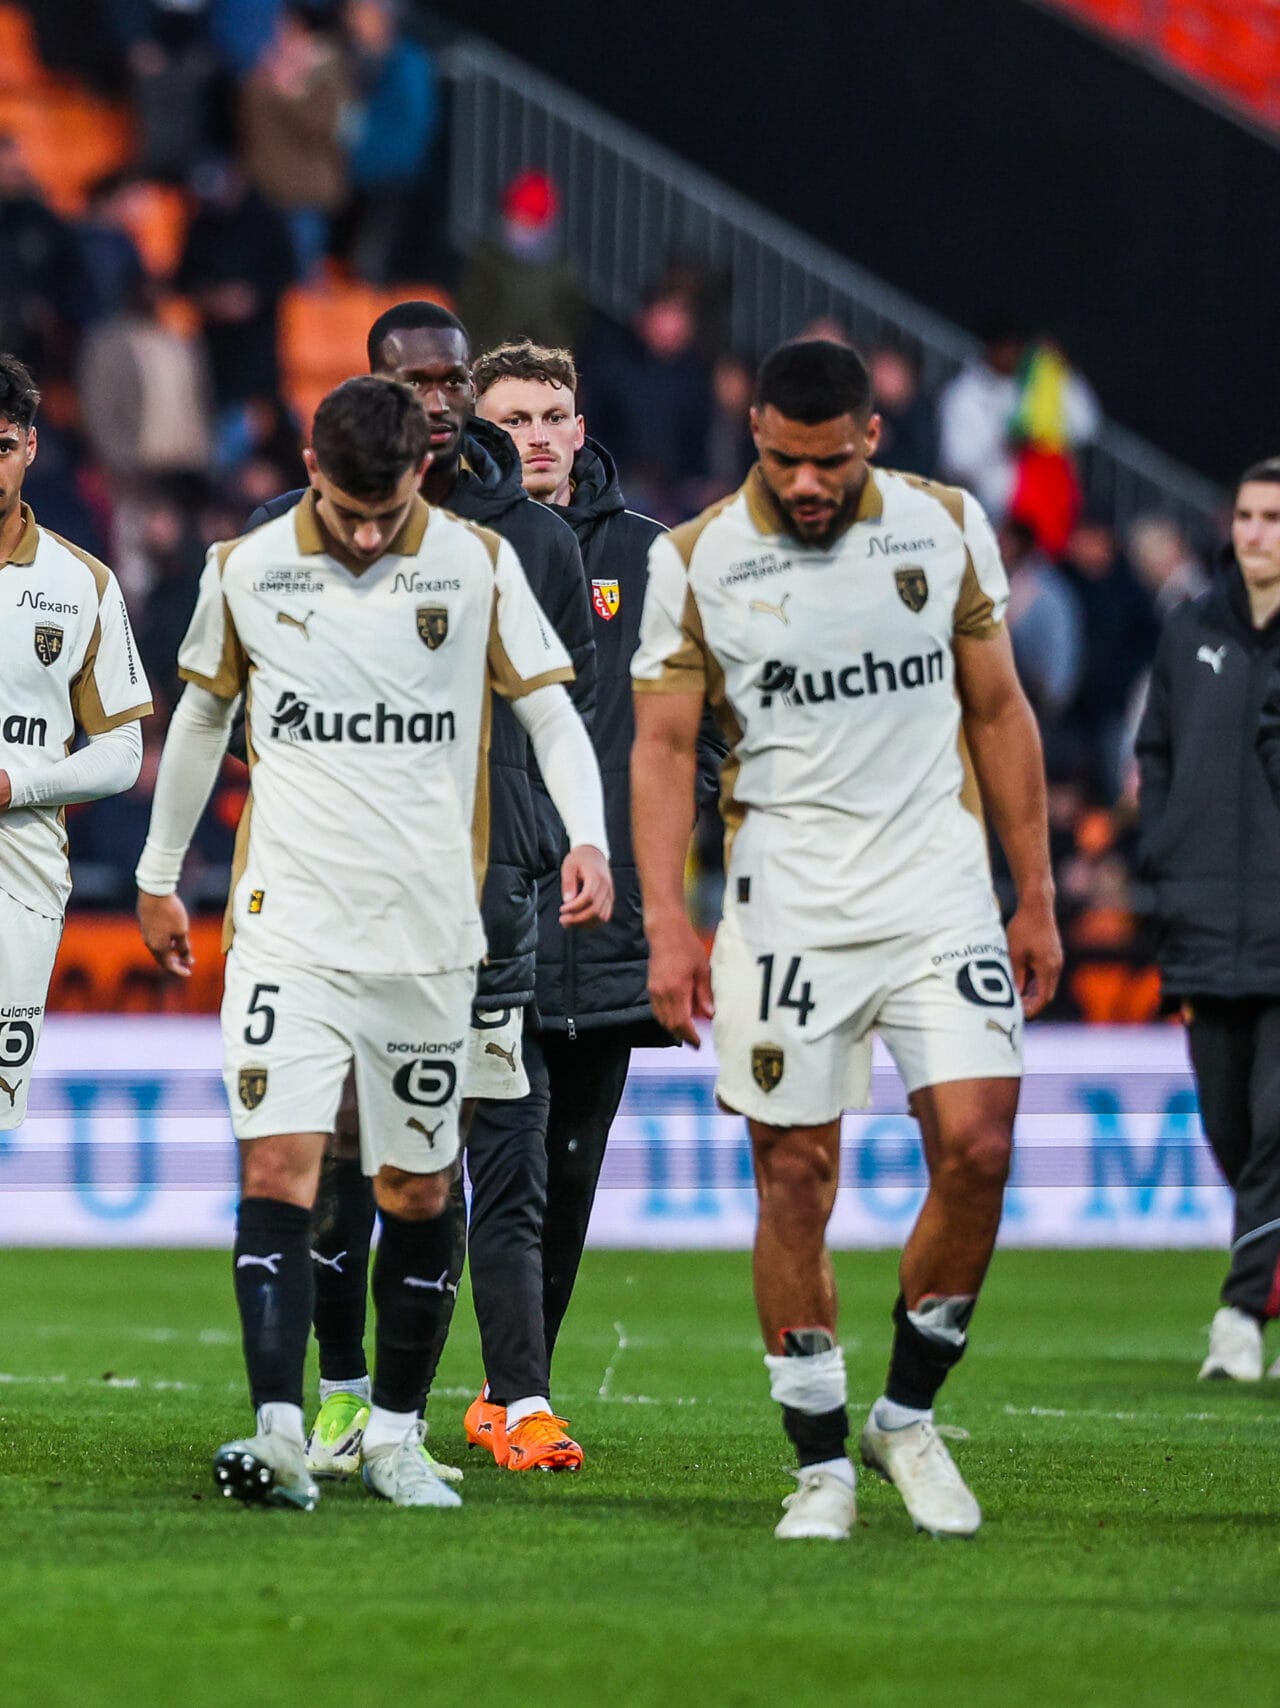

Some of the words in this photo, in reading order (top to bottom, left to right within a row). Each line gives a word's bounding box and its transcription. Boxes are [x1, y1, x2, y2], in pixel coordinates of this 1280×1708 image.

[866, 533, 936, 558] Nexans
[252, 582, 324, 593] LEMPEREUR
[390, 571, 460, 595] Nexans
[16, 590, 79, 615] Nexans
[753, 651, 943, 709] Auchan
[270, 691, 456, 743] Auchan
[757, 953, 815, 1027] 14
[243, 983, 280, 1045] 5
